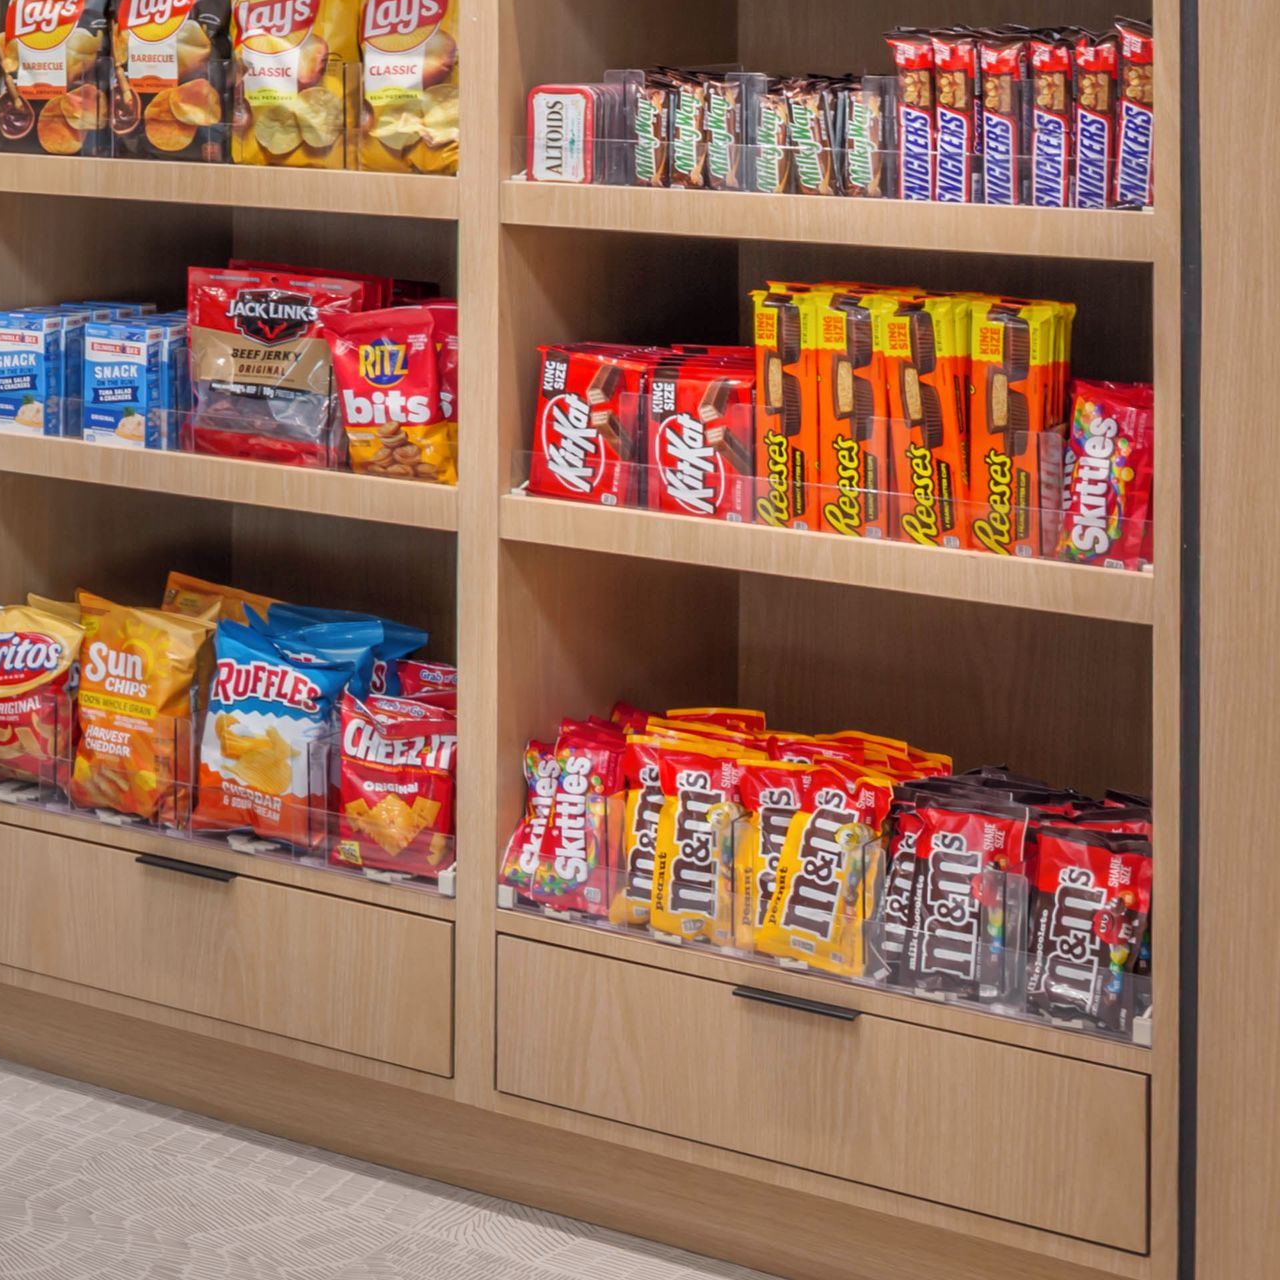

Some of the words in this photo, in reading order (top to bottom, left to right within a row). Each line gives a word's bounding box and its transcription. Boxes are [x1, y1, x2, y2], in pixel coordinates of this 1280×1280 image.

[22, 61, 64, 71] BARBECUE
[131, 54, 174, 63] BARBECUE
[369, 64, 417, 76] CLASSIC
[545, 100, 565, 175] ALTOIDS
[225, 299, 268, 319] JACK
[757, 312, 765, 339] KING
[767, 312, 775, 340] SIZE
[823, 315, 832, 343] KING
[834, 316, 843, 343] SIZE
[887, 322, 897, 350] KING
[898, 323, 907, 350] SIZE
[231, 348, 260, 359] BEEF
[261, 349, 302, 361] JERKY
[980, 327, 989, 355] KING
[990, 327, 1001, 355] SIZE
[94, 364, 138, 378] SNACK
[238, 364, 286, 376] ORIGINAL
[359, 344, 409, 379] RITZ
[3, 382, 31, 390] CRACKERS
[543, 361, 556, 391] KING
[555, 362, 568, 390] SIZE
[103, 394, 132, 402] CRACKERS
[342, 389, 431, 425] bits
[652, 382, 664, 413] KING
[664, 382, 675, 411] SIZE
[756, 429, 790, 528] Reese's
[824, 433, 862, 538] Reese's
[1071, 415, 1118, 554] Skittles
[902, 442, 939, 547] Reese's
[973, 449, 1013, 556] Reese's
[85, 641, 143, 683] Sun
[420, 670, 441, 682] Grab
[105, 677, 147, 698] CHIPS
[211, 658, 322, 713] RUFFLES
[102, 696, 129, 711] WHOLE
[129, 703, 152, 716] GRAIN
[86, 724, 131, 743] HARVEST
[344, 718, 457, 770] CHEEZ-IT
[85, 739, 131, 757] CHEDDAR
[721, 761, 733, 788] SHARE
[554, 756, 591, 883] Skittles
[983, 823, 996, 851] SHARE
[995, 829, 1006, 849] SIZE
[655, 851, 667, 911] peanut
[1108, 856, 1122, 887] SHARE
[1120, 864, 1132, 885] SIZE
[742, 866, 753, 926] peanut
